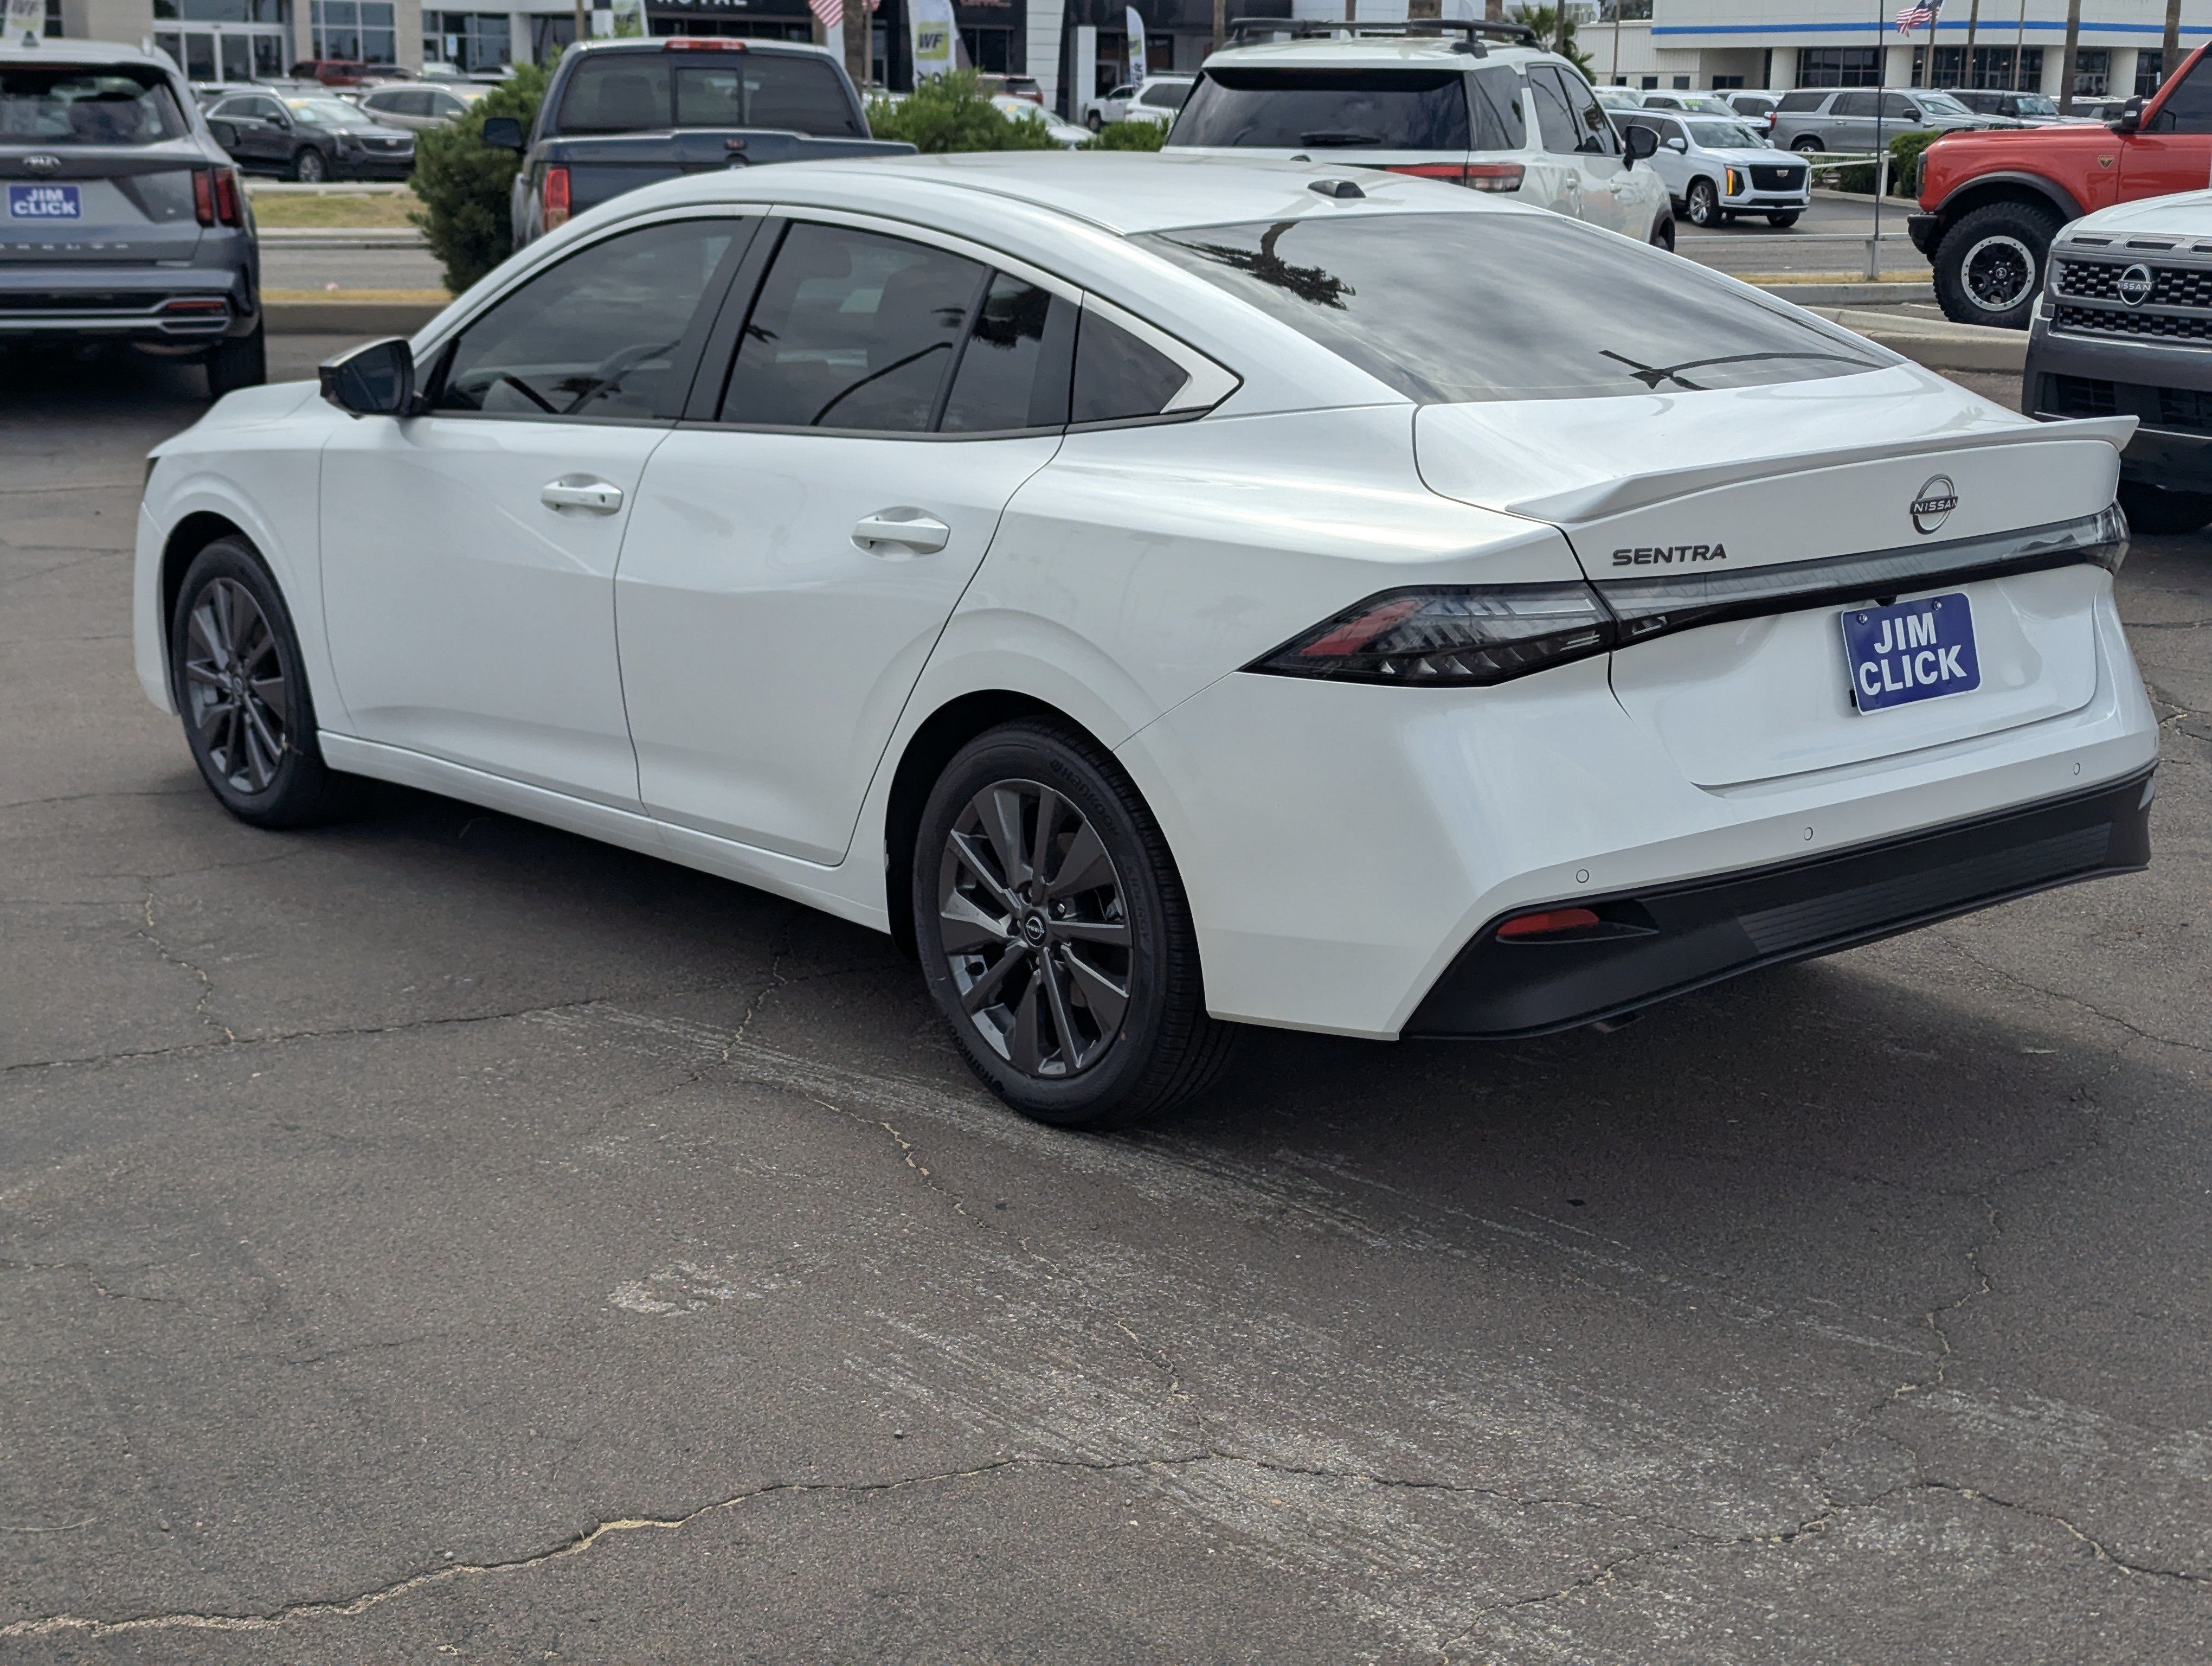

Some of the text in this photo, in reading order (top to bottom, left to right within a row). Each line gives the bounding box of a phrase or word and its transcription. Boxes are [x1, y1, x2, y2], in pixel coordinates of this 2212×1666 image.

[27, 189, 63, 201] JIM
[14, 201, 76, 215] CLICK
[1913, 498, 1957, 512] NISSAN
[1612, 543, 1727, 566] SENTRA
[1874, 612, 1937, 654] JIM
[1859, 645, 1967, 696] CLICK
